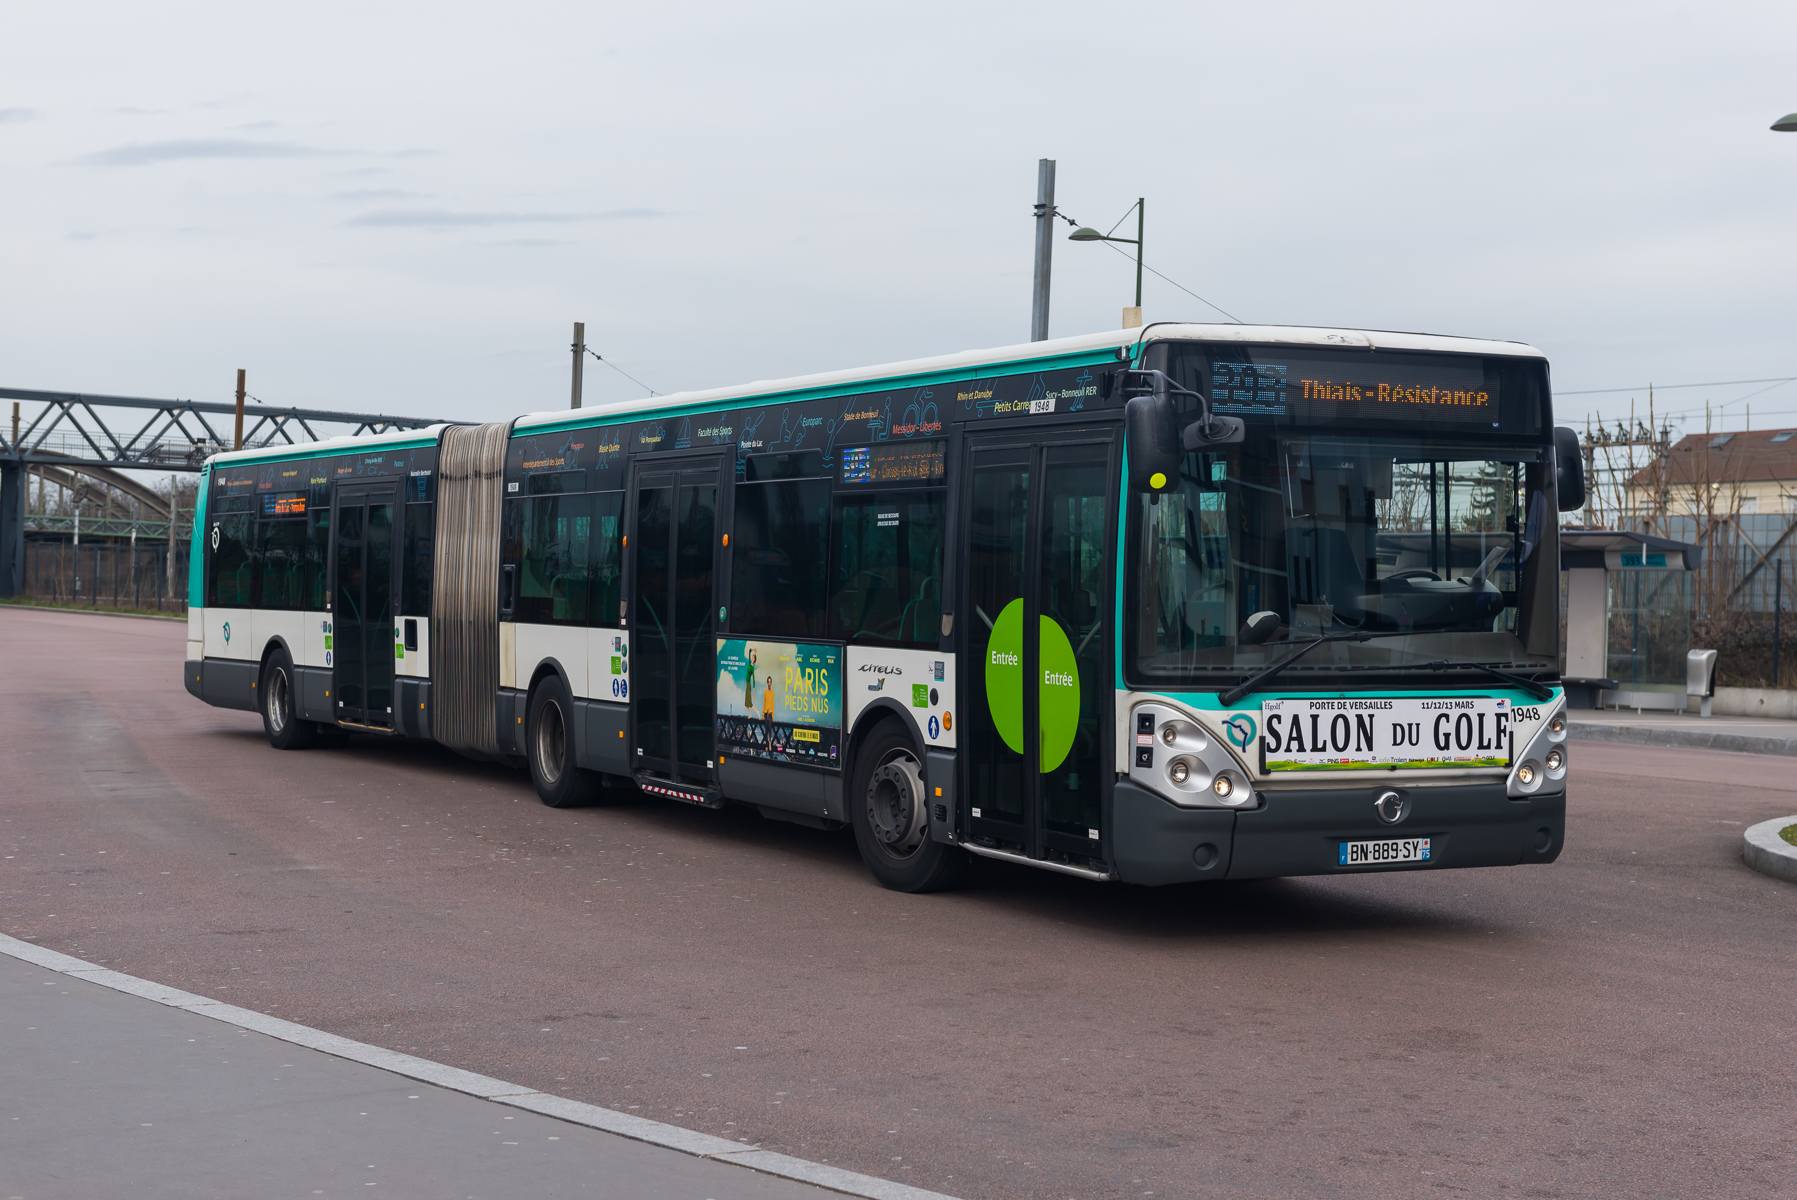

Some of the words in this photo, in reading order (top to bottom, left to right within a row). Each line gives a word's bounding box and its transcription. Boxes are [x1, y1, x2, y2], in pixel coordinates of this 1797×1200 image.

[1086, 386, 1098, 396] RER
[1301, 380, 1362, 401] Thiais
[994, 401, 1012, 413] Petits
[1034, 401, 1050, 413] 1948
[991, 650, 1018, 666] Entrée
[785, 666, 829, 696] PARIS
[1044, 670, 1073, 687] Entrée
[784, 695, 808, 712] PIEDS
[811, 697, 829, 714] NUS
[1309, 701, 1335, 710] PORTE
[1336, 701, 1347, 710] DE
[1348, 701, 1393, 710] VERSAILLES
[1421, 701, 1453, 710] 11/12/13
[1454, 700, 1475, 710] MARS
[1511, 707, 1541, 723] 1948
[1266, 713, 1375, 754] SALON
[1391, 722, 1421, 747] DU
[1433, 712, 1509, 751] GOLF
[1422, 849, 1431, 859] 75
